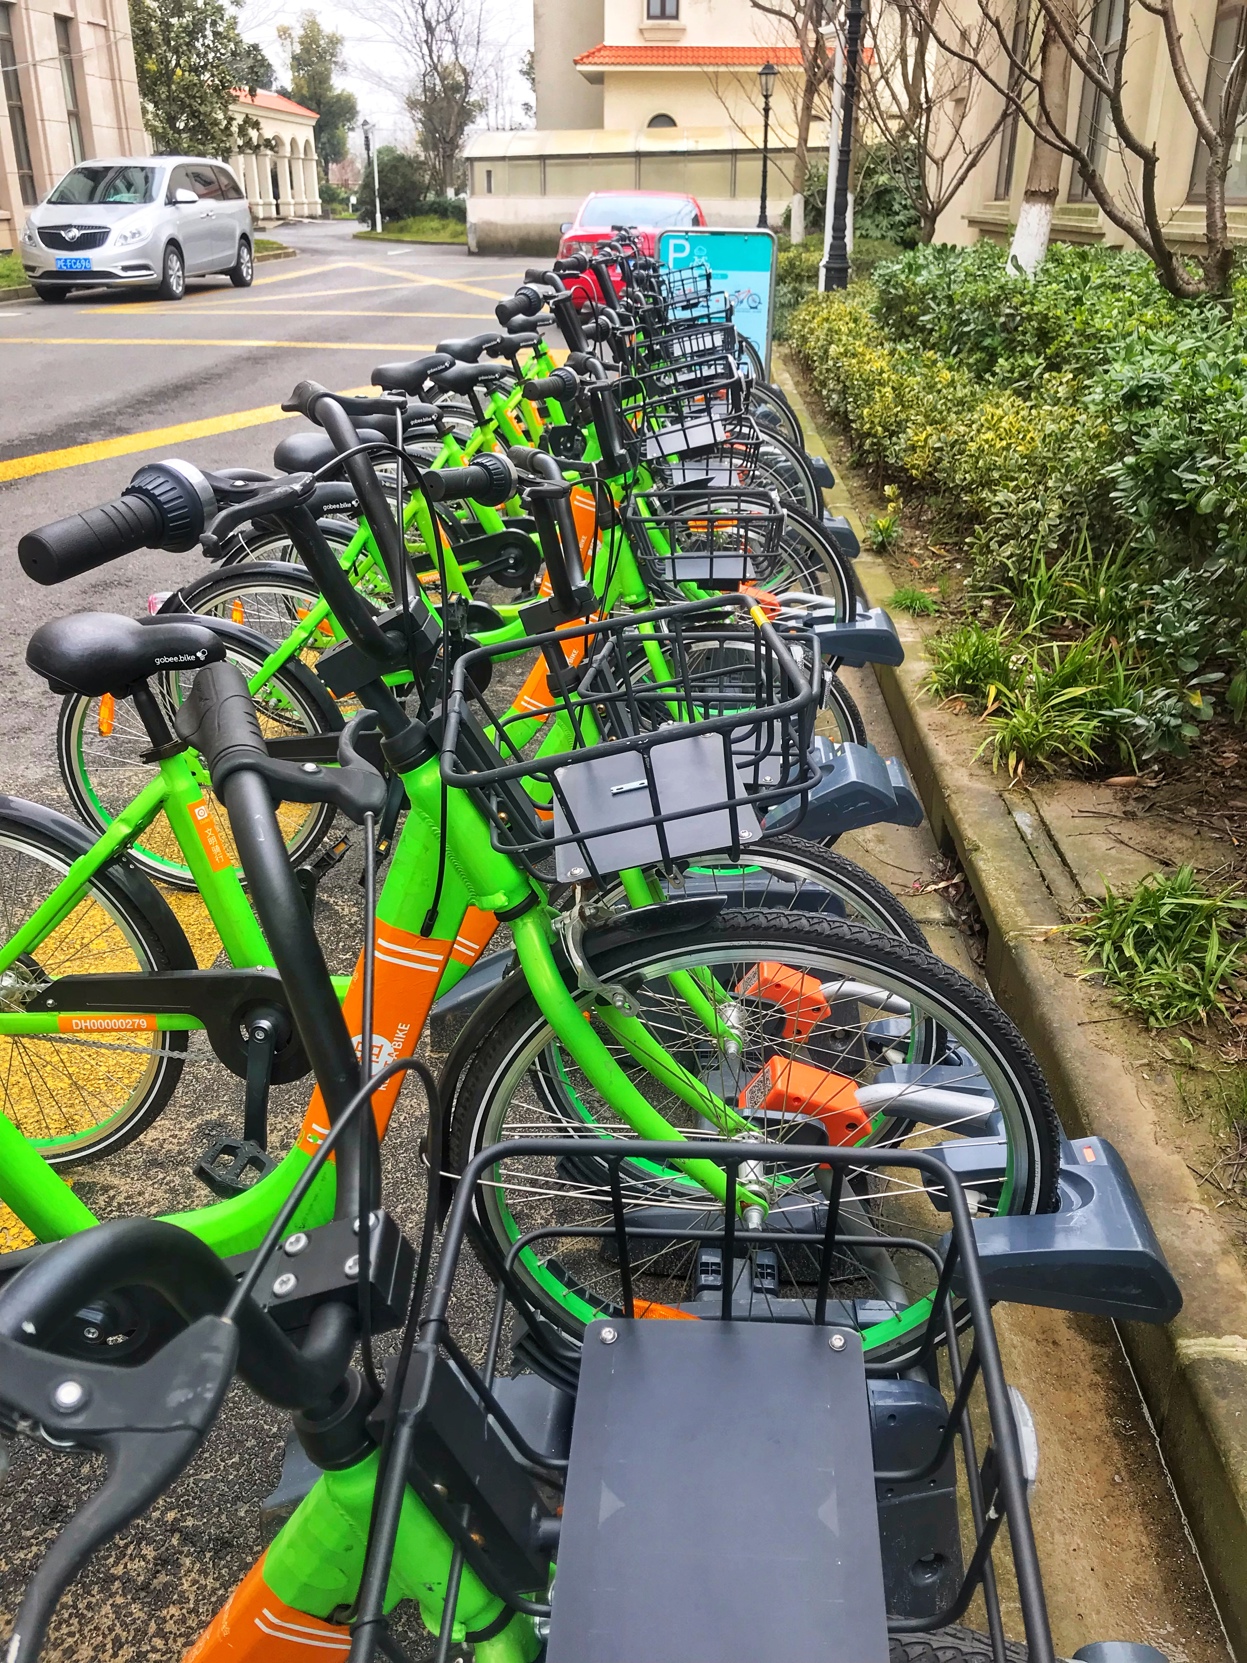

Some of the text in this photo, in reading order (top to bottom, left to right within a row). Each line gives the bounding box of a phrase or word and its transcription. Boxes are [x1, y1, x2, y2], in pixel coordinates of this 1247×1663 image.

[668, 239, 690, 269] P
[154, 654, 196, 665] gobee.bike
[72, 1019, 147, 1030] DH00000279
[391, 1022, 411, 1049] BIKE
